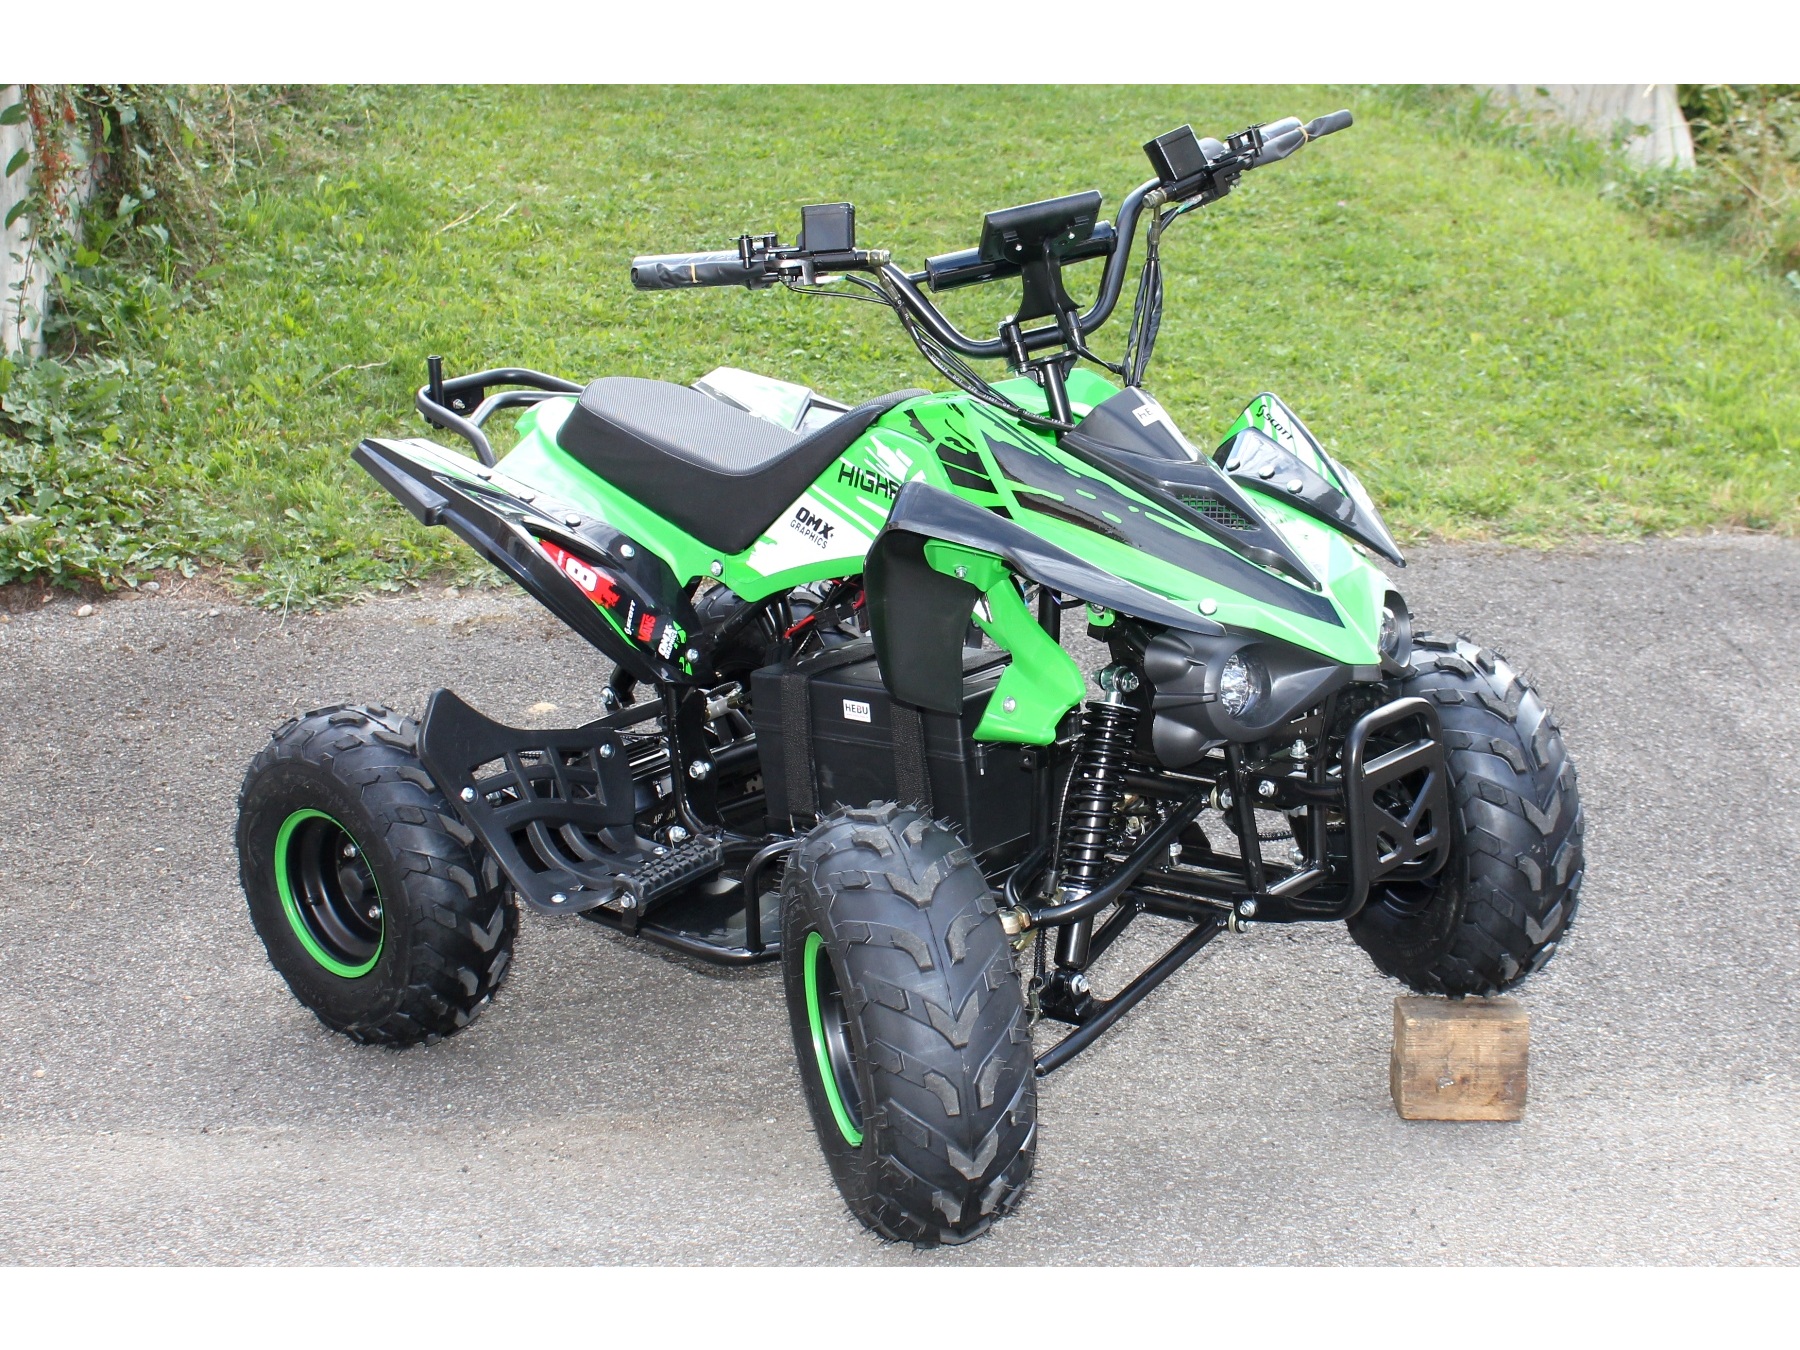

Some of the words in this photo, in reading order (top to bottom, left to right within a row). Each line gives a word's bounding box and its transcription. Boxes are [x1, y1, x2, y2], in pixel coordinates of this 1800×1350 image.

[1262, 412, 1293, 440] SCOTT
[789, 519, 828, 549] GRAPHICS
[565, 556, 598, 592] 8
[637, 613, 656, 642] VANS
[844, 703, 869, 715] HEBU
